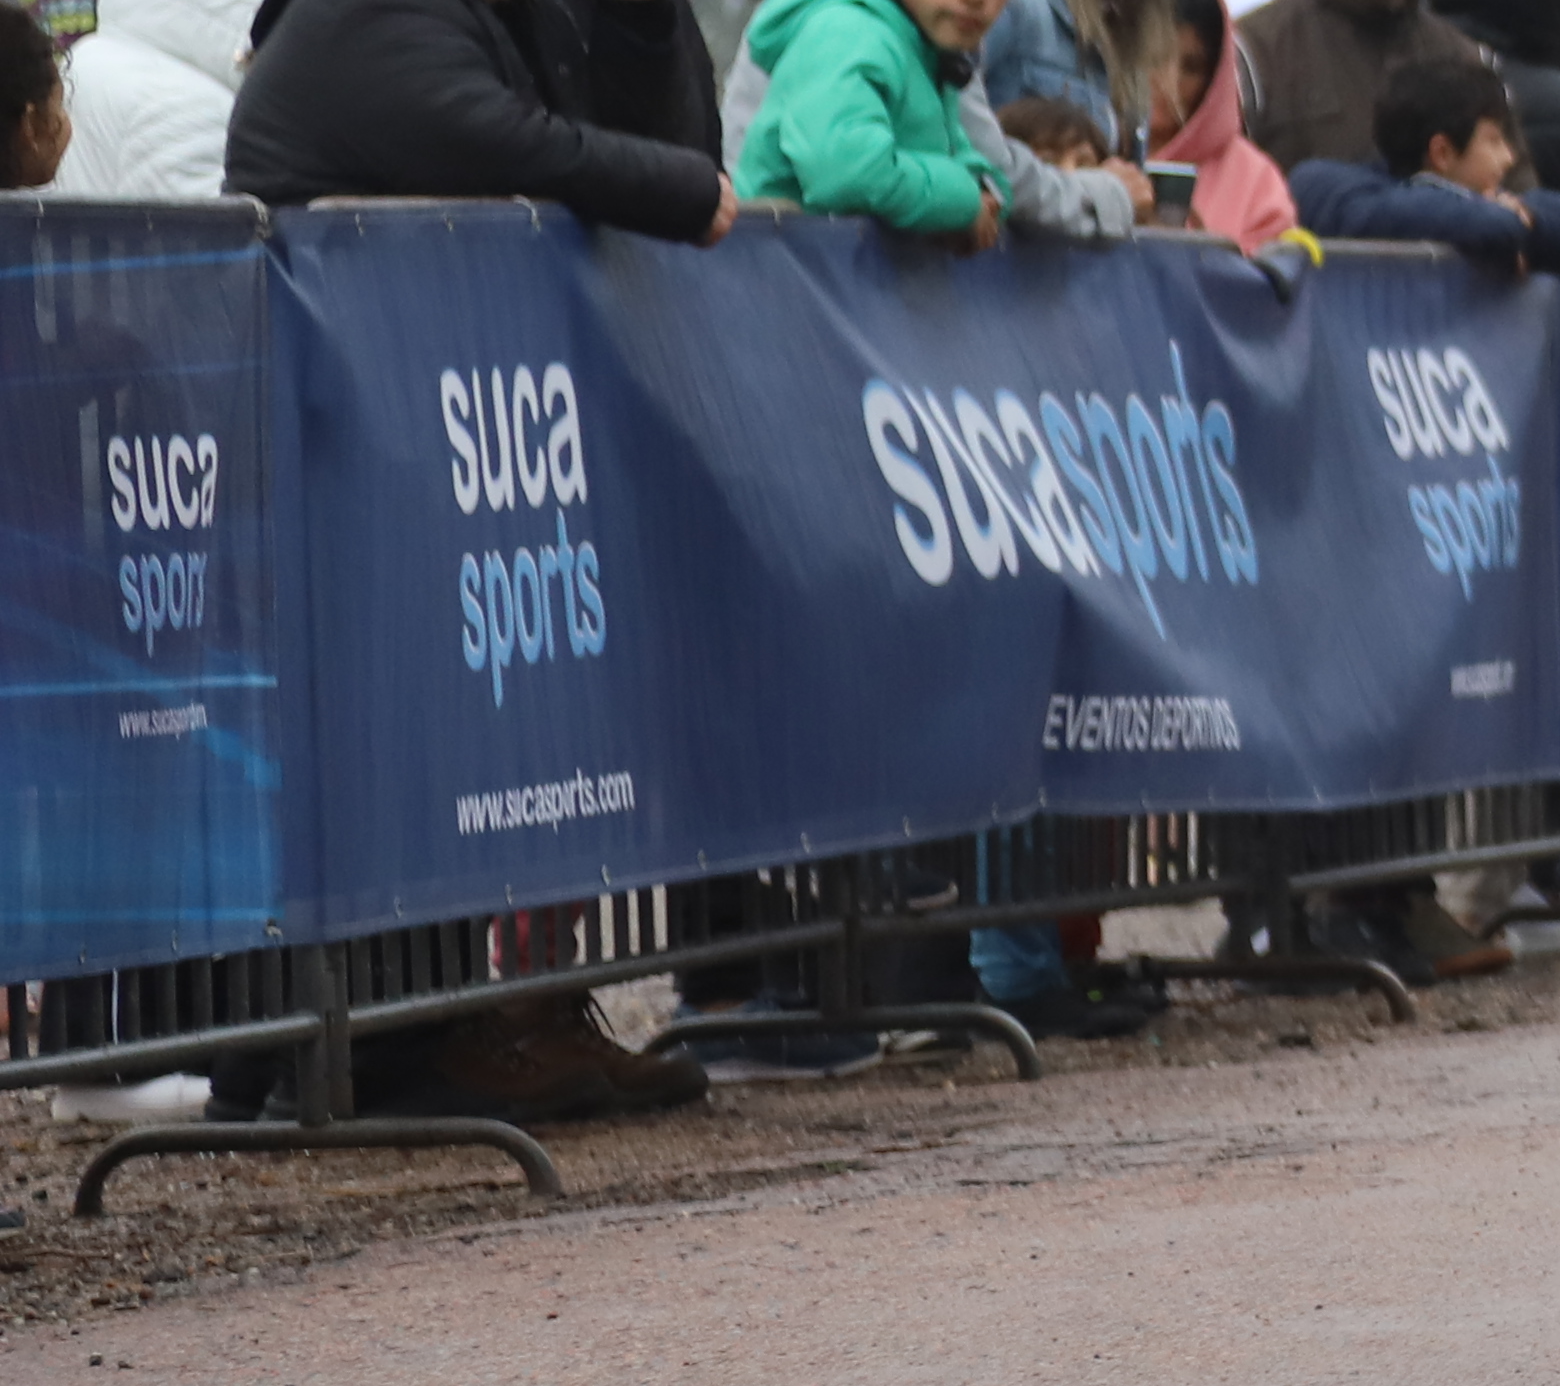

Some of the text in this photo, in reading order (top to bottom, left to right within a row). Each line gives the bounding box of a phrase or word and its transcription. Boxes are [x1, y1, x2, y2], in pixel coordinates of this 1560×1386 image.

[440, 361, 587, 514] suca
[1367, 346, 1510, 462] suca
[107, 433, 218, 533] suca
[862, 337, 1259, 641] sucasports
[460, 506, 606, 709] sports
[1041, 693, 1150, 752] EVENTOS
[456, 767, 636, 835] www.sucasports.com
